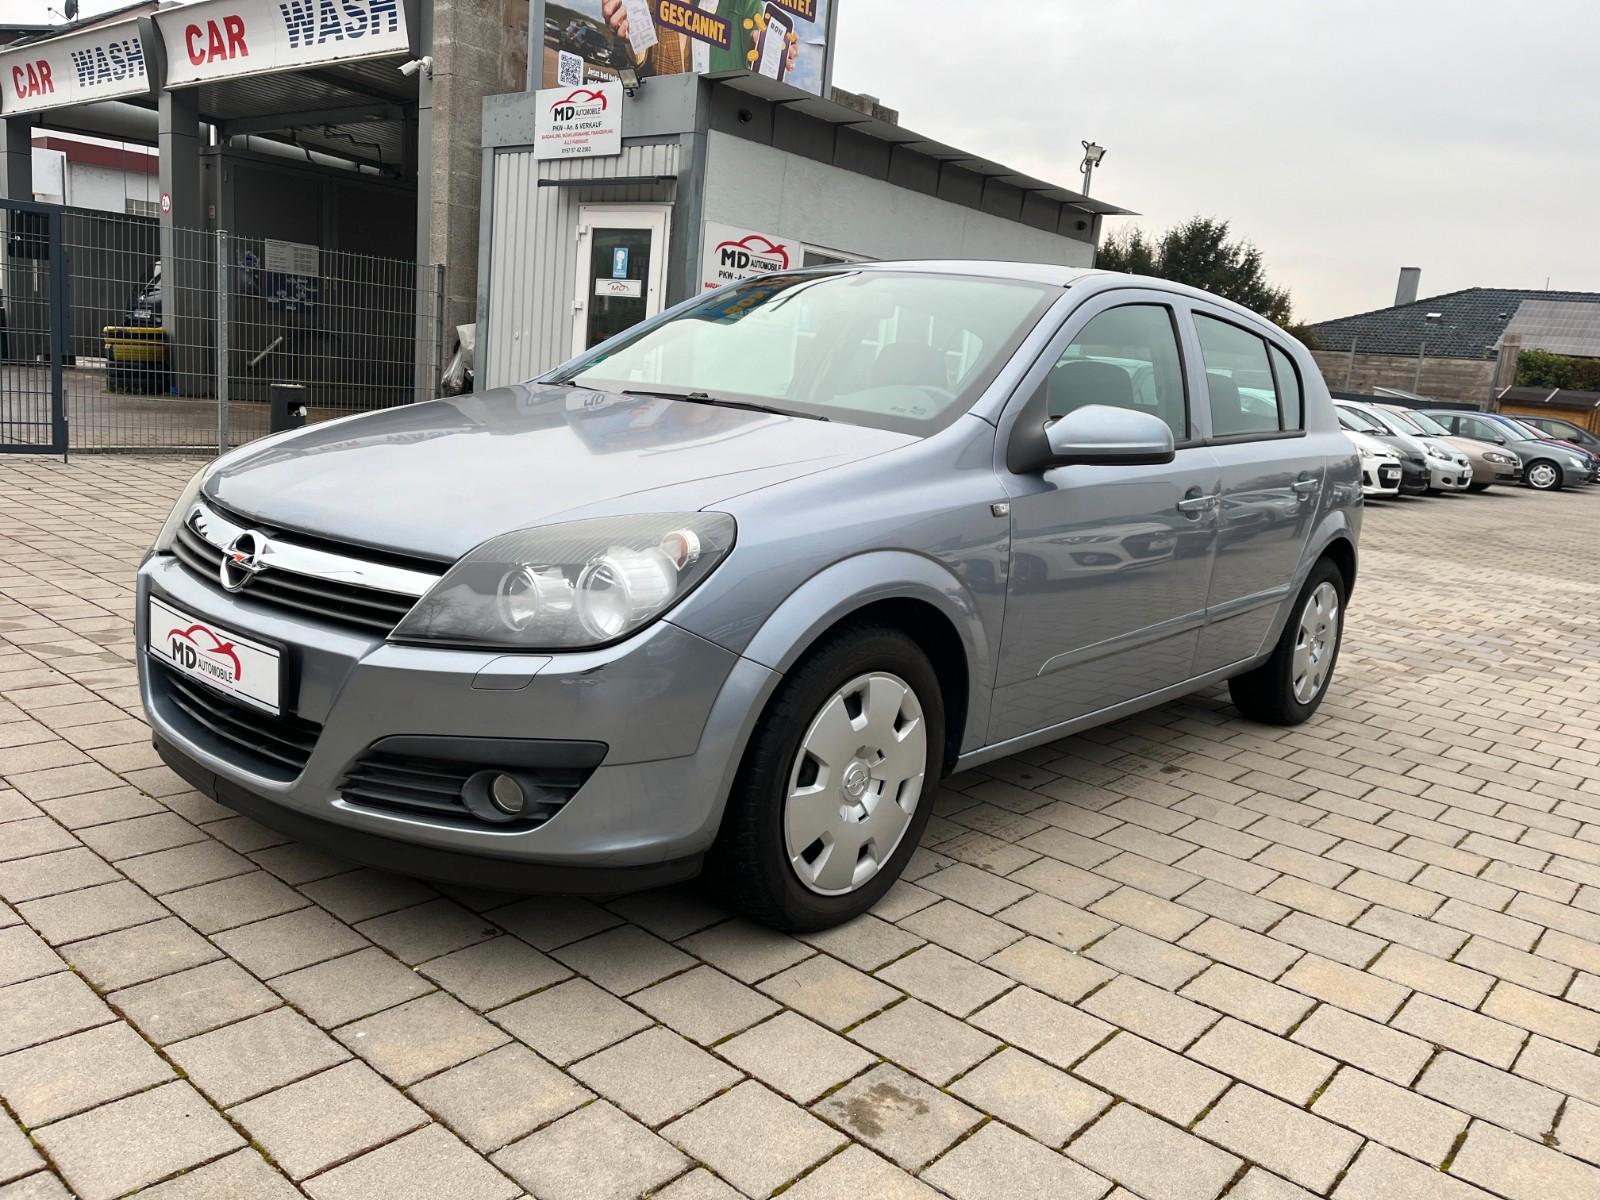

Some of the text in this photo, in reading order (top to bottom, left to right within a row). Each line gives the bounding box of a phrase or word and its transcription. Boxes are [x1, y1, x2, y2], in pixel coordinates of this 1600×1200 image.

[185, 0, 398, 66] CAR WASH
[660, 1, 727, 44] GESCANNT.
[12, 38, 145, 99] CAR WASH
[554, 106, 601, 121] MD AUTOMOBILE
[719, 270, 733, 280] PKW
[721, 248, 782, 272] MD AUTOMOBILE
[172, 637, 233, 683] MD AUTOMOBILE
